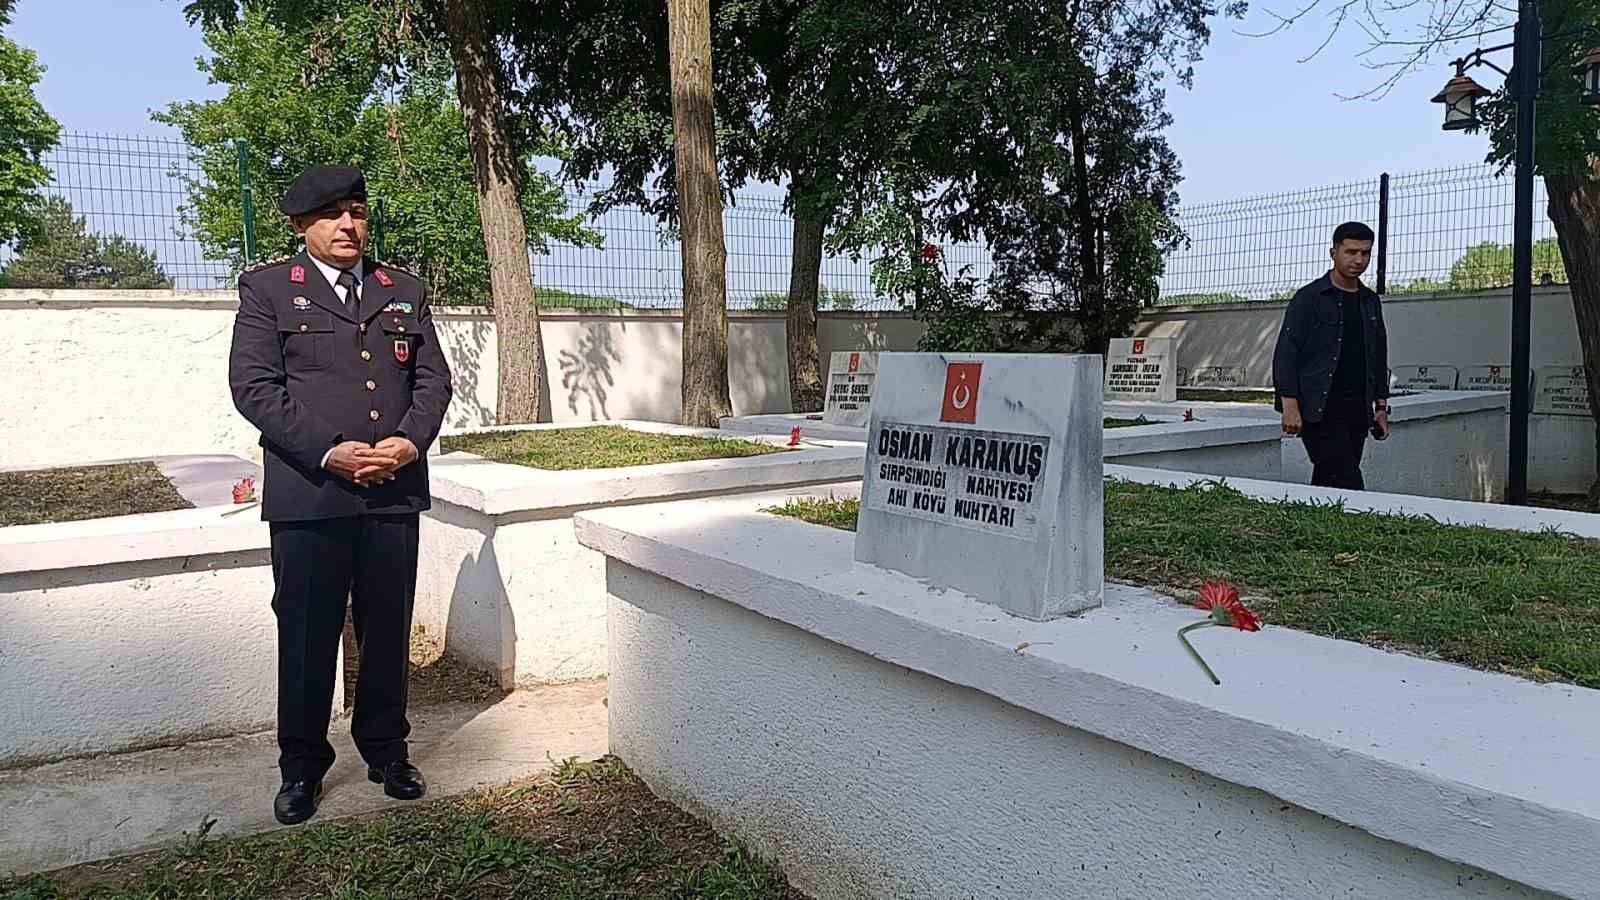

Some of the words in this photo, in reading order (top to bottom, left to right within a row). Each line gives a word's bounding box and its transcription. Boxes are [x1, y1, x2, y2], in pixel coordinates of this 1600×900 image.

[878, 428, 934, 463] OSMAN
[945, 435, 1044, 483] KARAKUŞ
[887, 487, 908, 507] AHI
[913, 486, 947, 514] KÖYÜ
[954, 498, 1016, 528] MUHTARI
[966, 475, 1033, 504] NAHİYESİ
